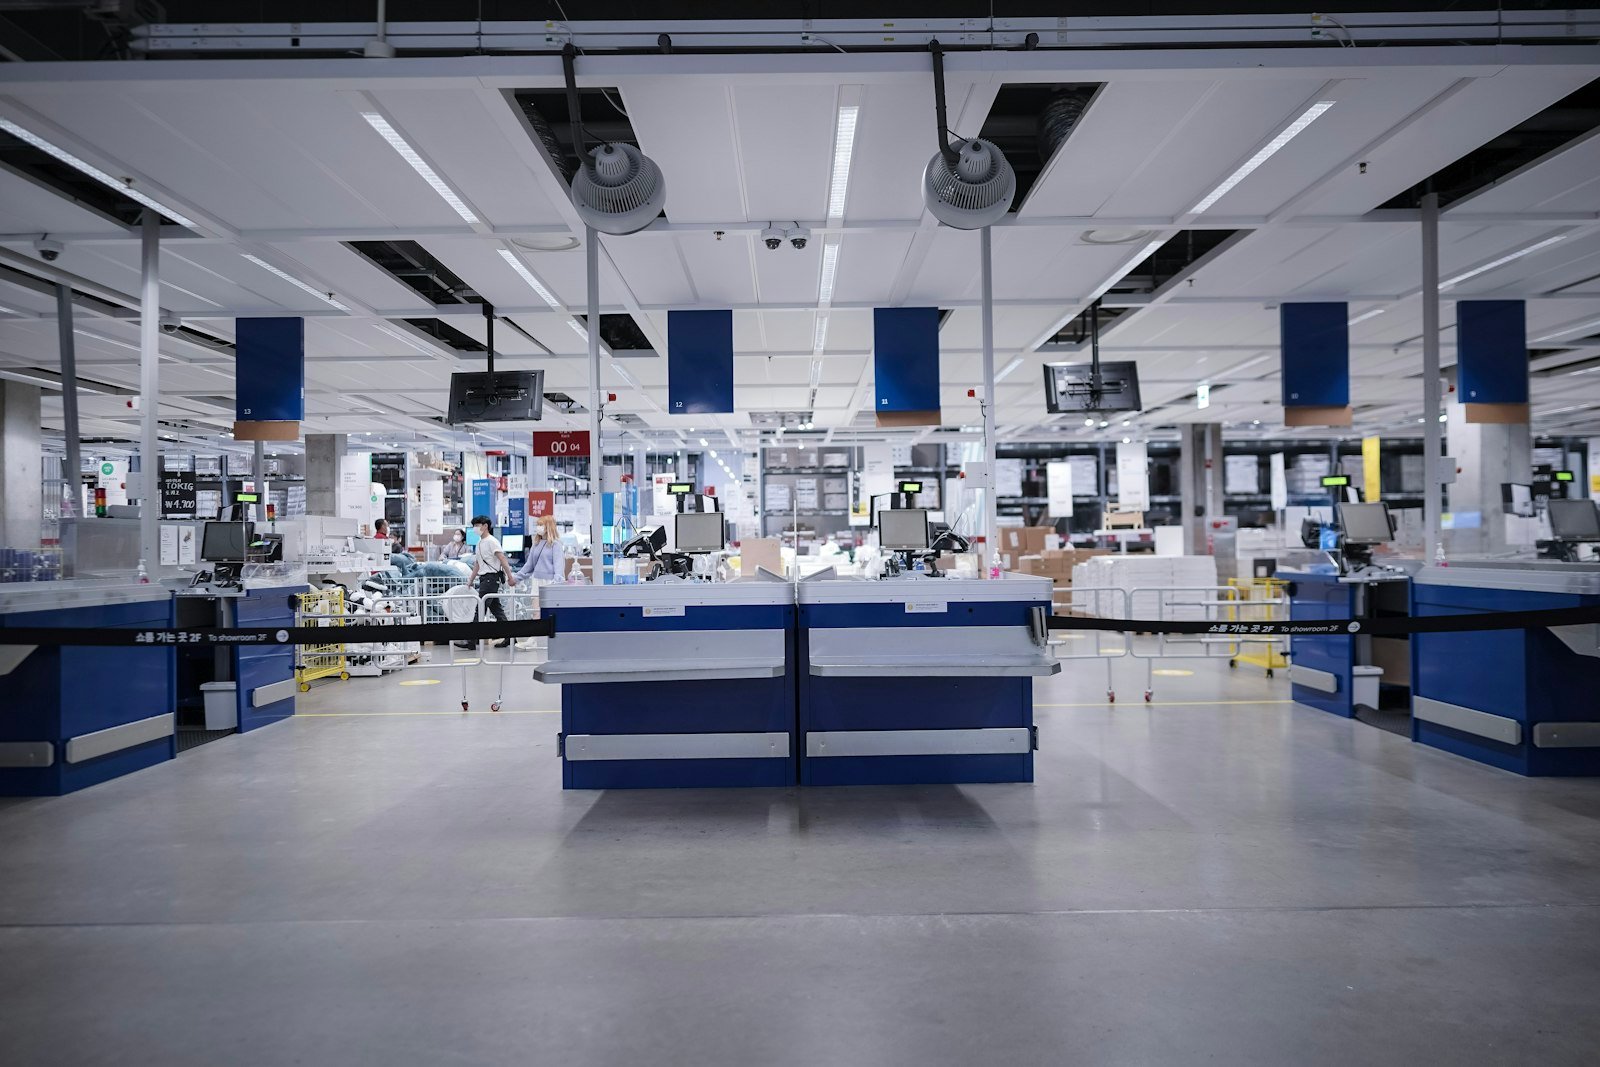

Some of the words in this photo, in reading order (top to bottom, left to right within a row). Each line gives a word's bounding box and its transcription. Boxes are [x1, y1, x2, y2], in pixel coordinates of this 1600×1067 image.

[550, 441, 567, 453] 00
[570, 443, 581, 451] 04
[1229, 624, 1249, 632] 가는
[156, 631, 176, 643] 가는
[189, 633, 202, 643] 2F
[257, 633, 268, 641] 2F
